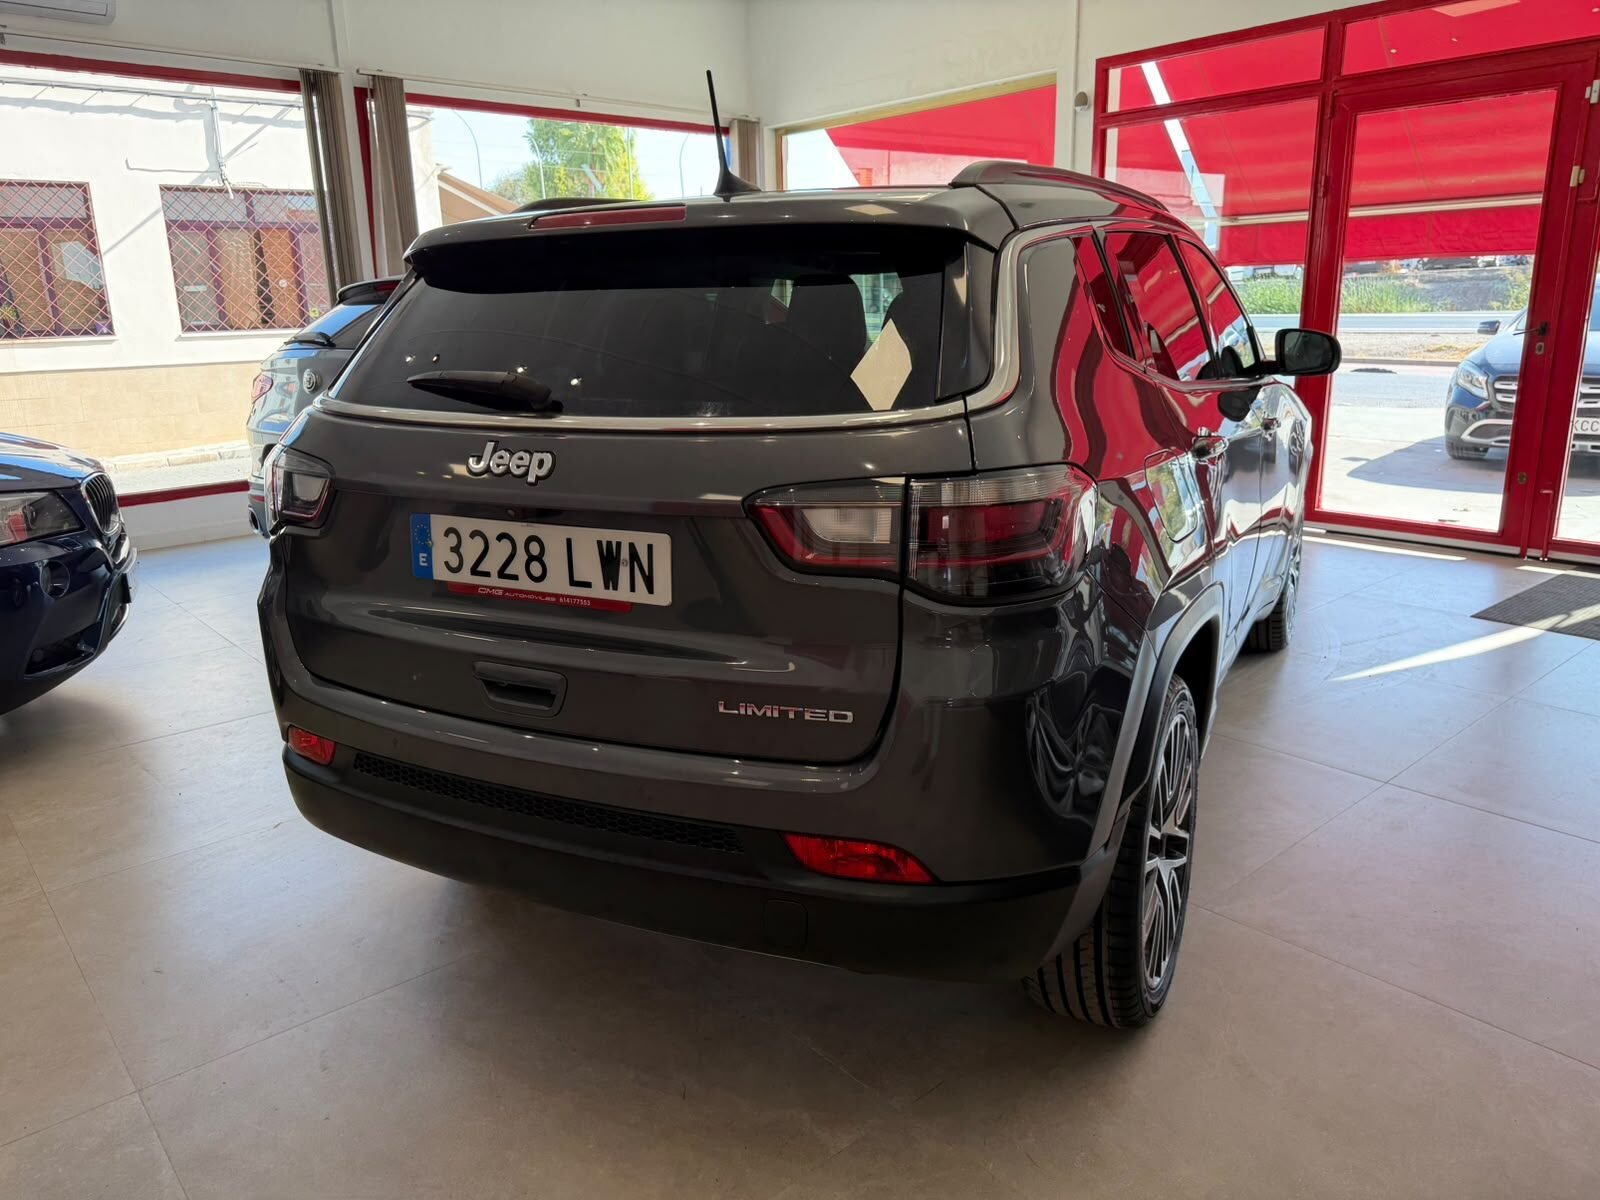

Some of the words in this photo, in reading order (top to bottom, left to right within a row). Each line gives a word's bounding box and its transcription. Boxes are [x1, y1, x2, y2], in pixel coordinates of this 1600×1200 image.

[467, 440, 555, 485] Jeep
[419, 552, 429, 567] E
[443, 526, 548, 583] 3228
[566, 537, 655, 595] LWN
[478, 586, 504, 596] CMG
[718, 700, 854, 724] LIMITED
